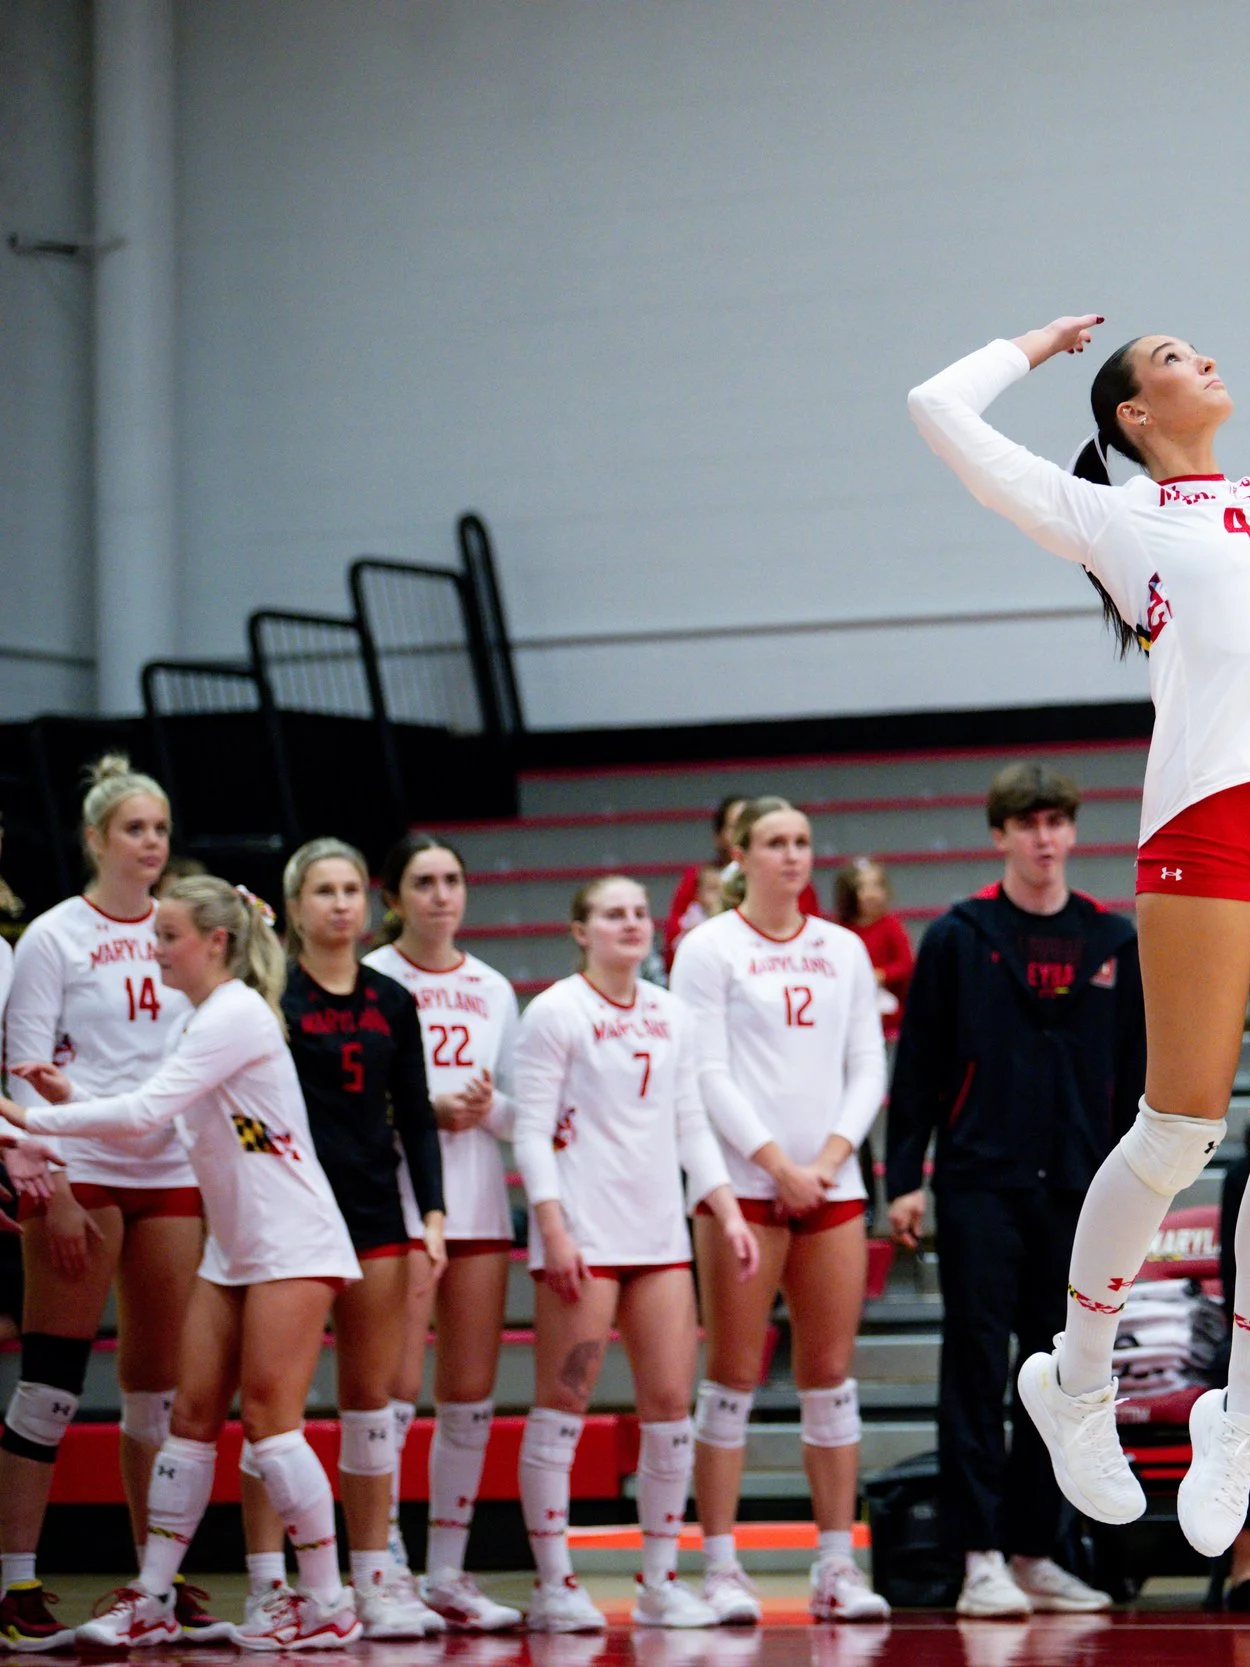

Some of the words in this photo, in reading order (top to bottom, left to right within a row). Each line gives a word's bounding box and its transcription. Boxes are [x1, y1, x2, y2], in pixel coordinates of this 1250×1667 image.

[125, 976, 160, 1021] 14
[412, 986, 488, 1019] ARYLAND
[784, 986, 815, 1027] 12
[341, 1042, 364, 1093] 5
[428, 1025, 474, 1067] 22
[633, 1052, 650, 1098] 7
